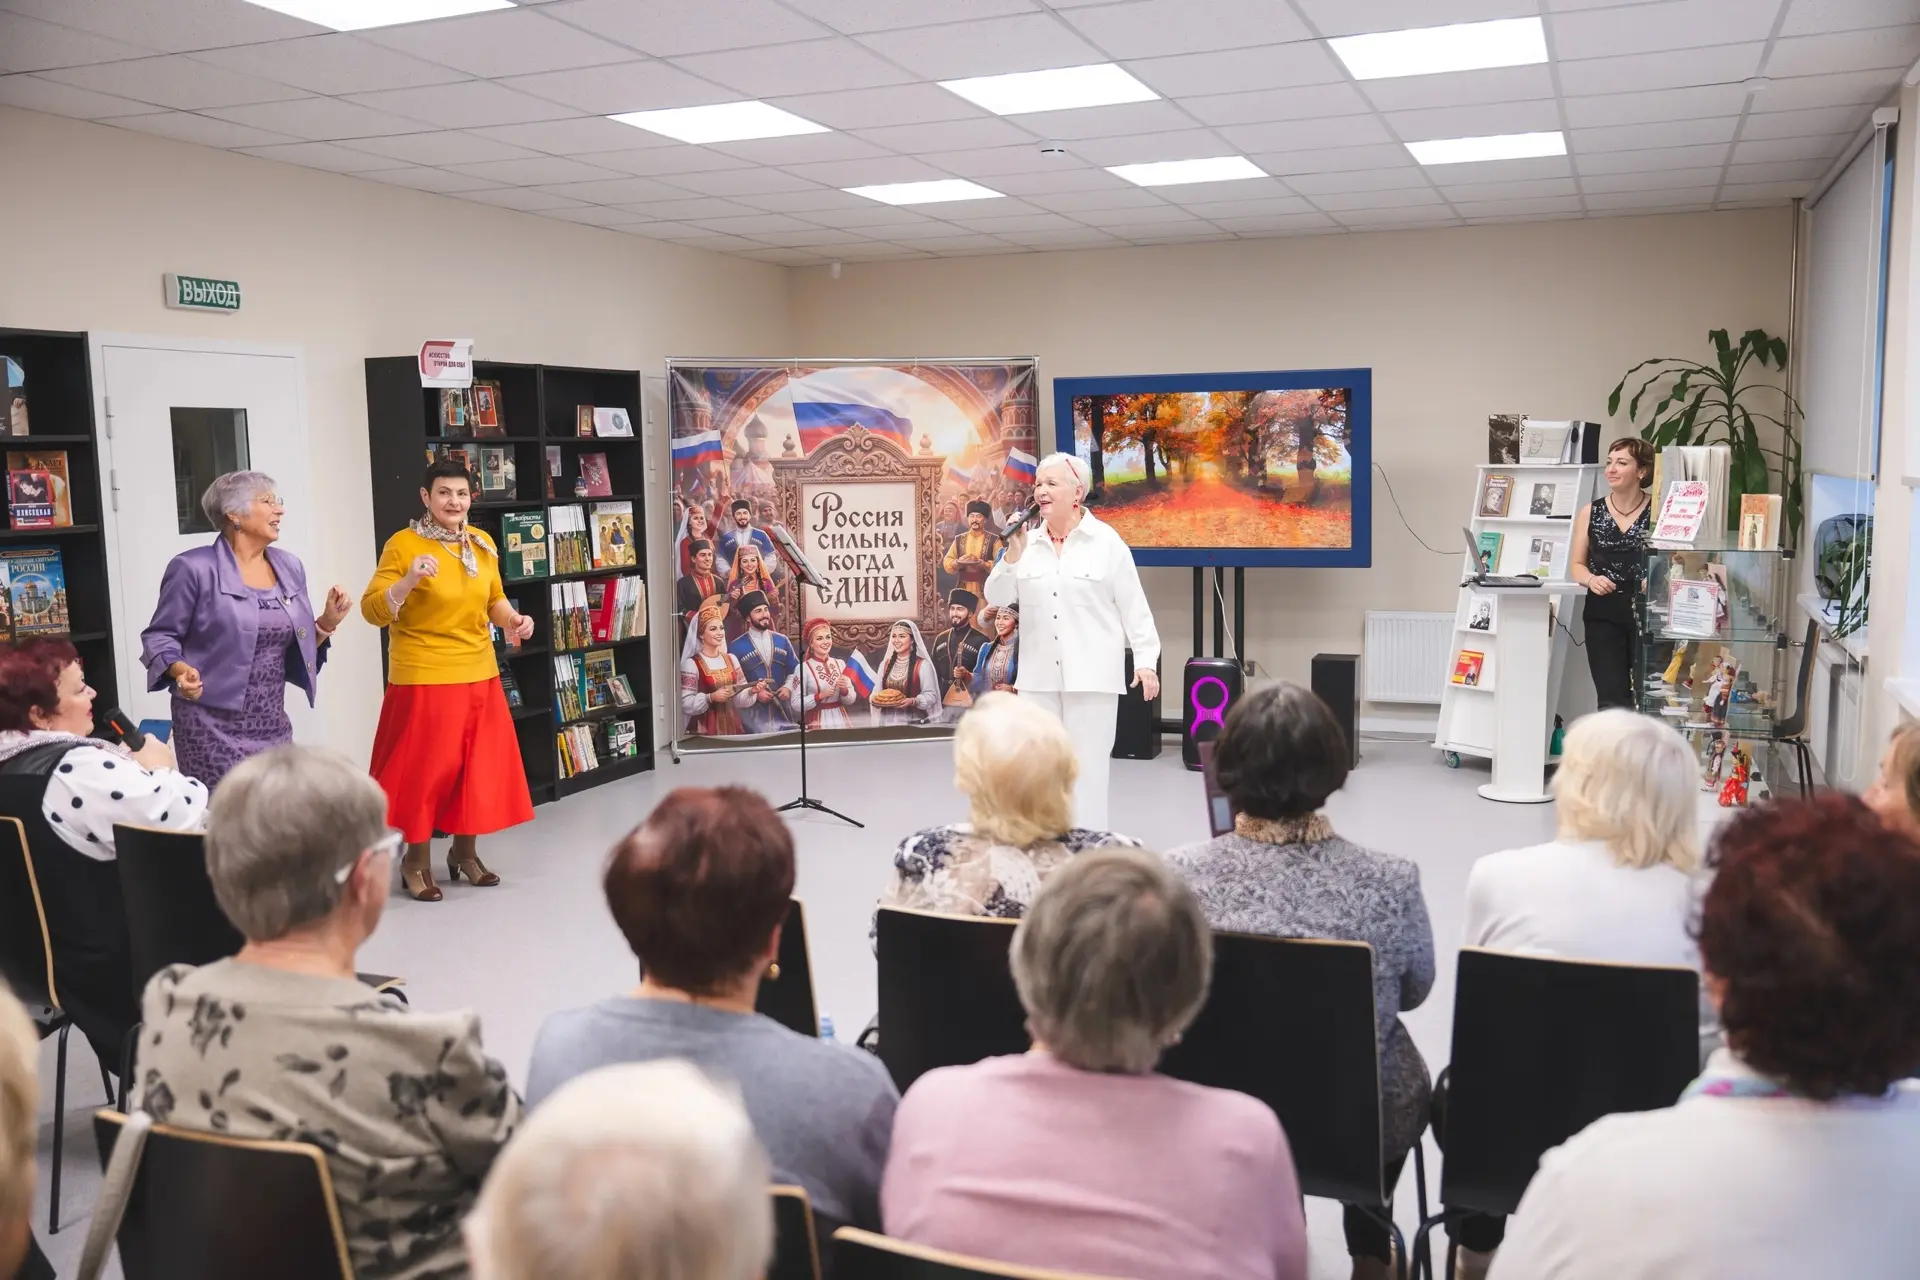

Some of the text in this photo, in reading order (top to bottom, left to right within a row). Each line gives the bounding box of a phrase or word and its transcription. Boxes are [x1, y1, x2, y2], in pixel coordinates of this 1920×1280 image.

[182, 279, 238, 307] ВЫХОД
[16, 508, 51, 517] ПЛИСЕЦКАЯ
[508, 514, 541, 522] Декабристы
[11, 562, 46, 573] РОССИИ
